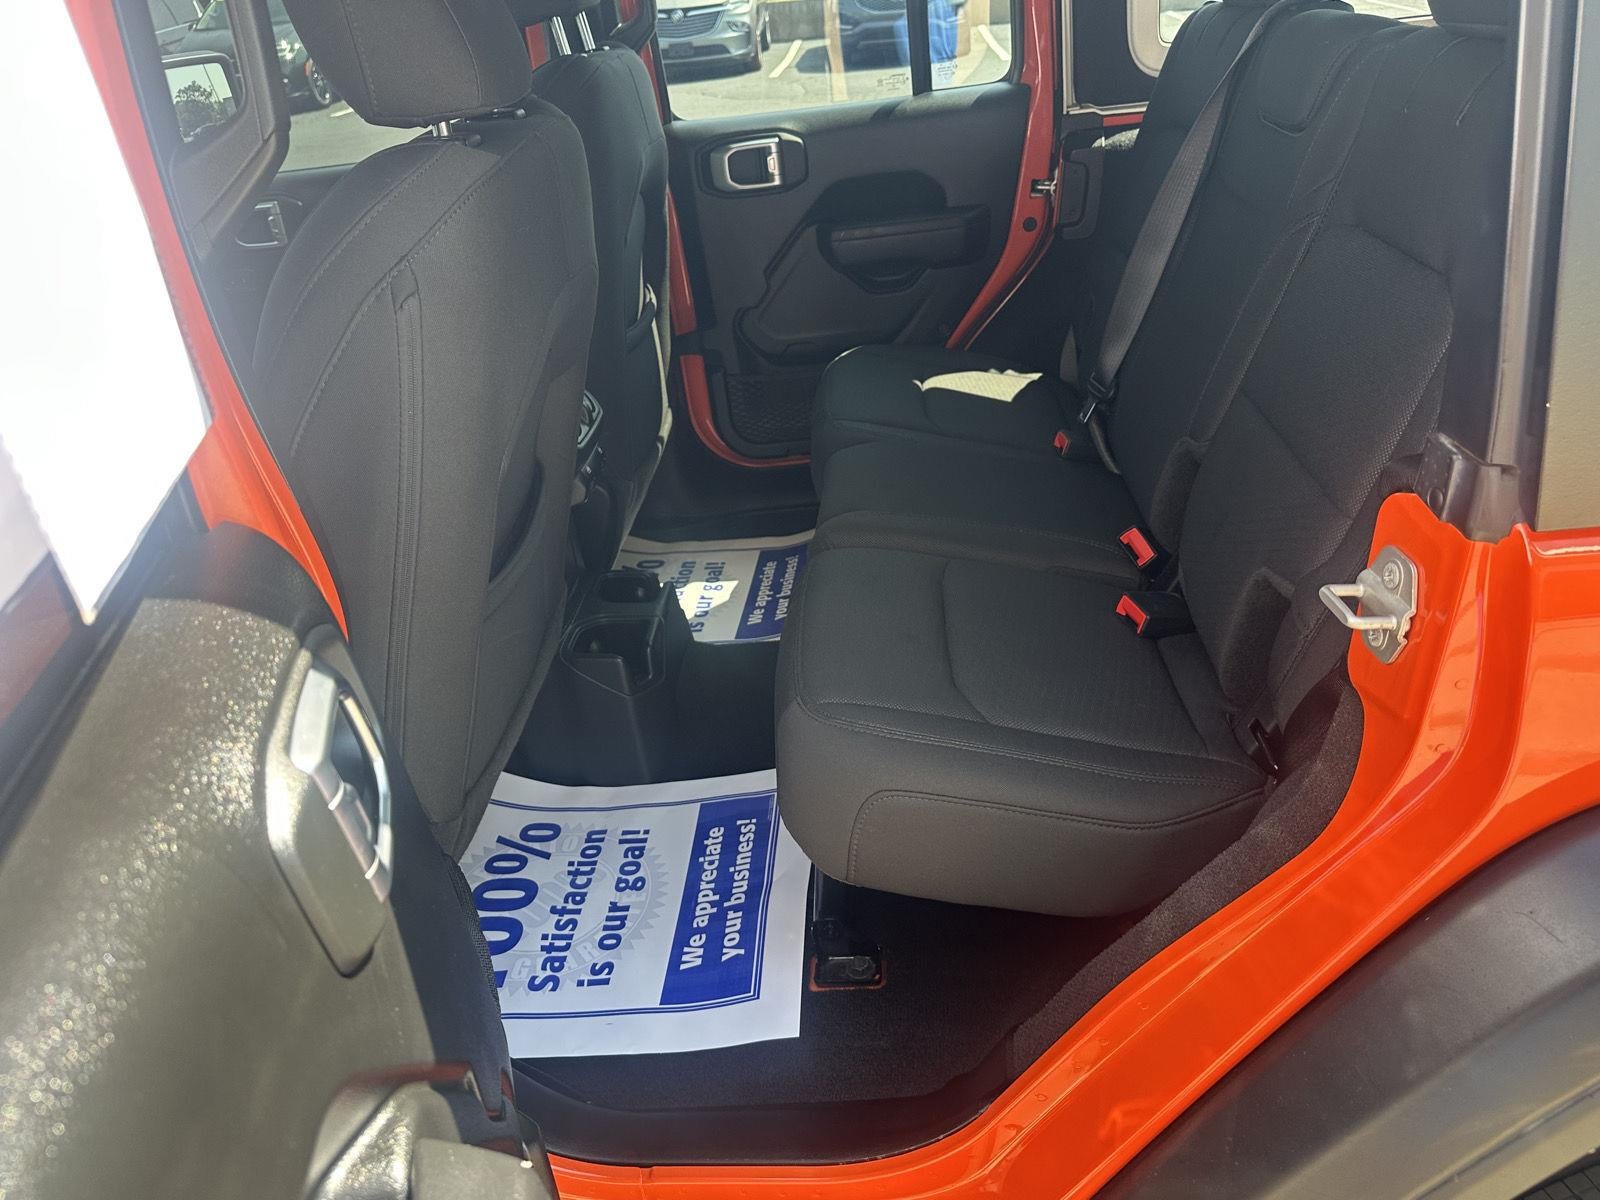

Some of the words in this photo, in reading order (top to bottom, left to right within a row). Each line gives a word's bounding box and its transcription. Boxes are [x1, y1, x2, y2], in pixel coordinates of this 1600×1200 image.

[694, 595, 713, 617] our
[704, 561, 726, 591] goal!
[755, 561, 777, 608] appreciate
[776, 554, 799, 597] business!
[747, 608, 765, 625] We
[774, 598, 790, 620] your
[724, 818, 757, 907] business!
[472, 822, 561, 988] 00%
[528, 829, 608, 992] Satisfaction
[576, 961, 615, 987] is
[598, 901, 631, 951] our
[615, 829, 650, 892] goal!
[679, 933, 706, 970] We
[693, 826, 724, 928] appreciate
[721, 911, 745, 962] your
